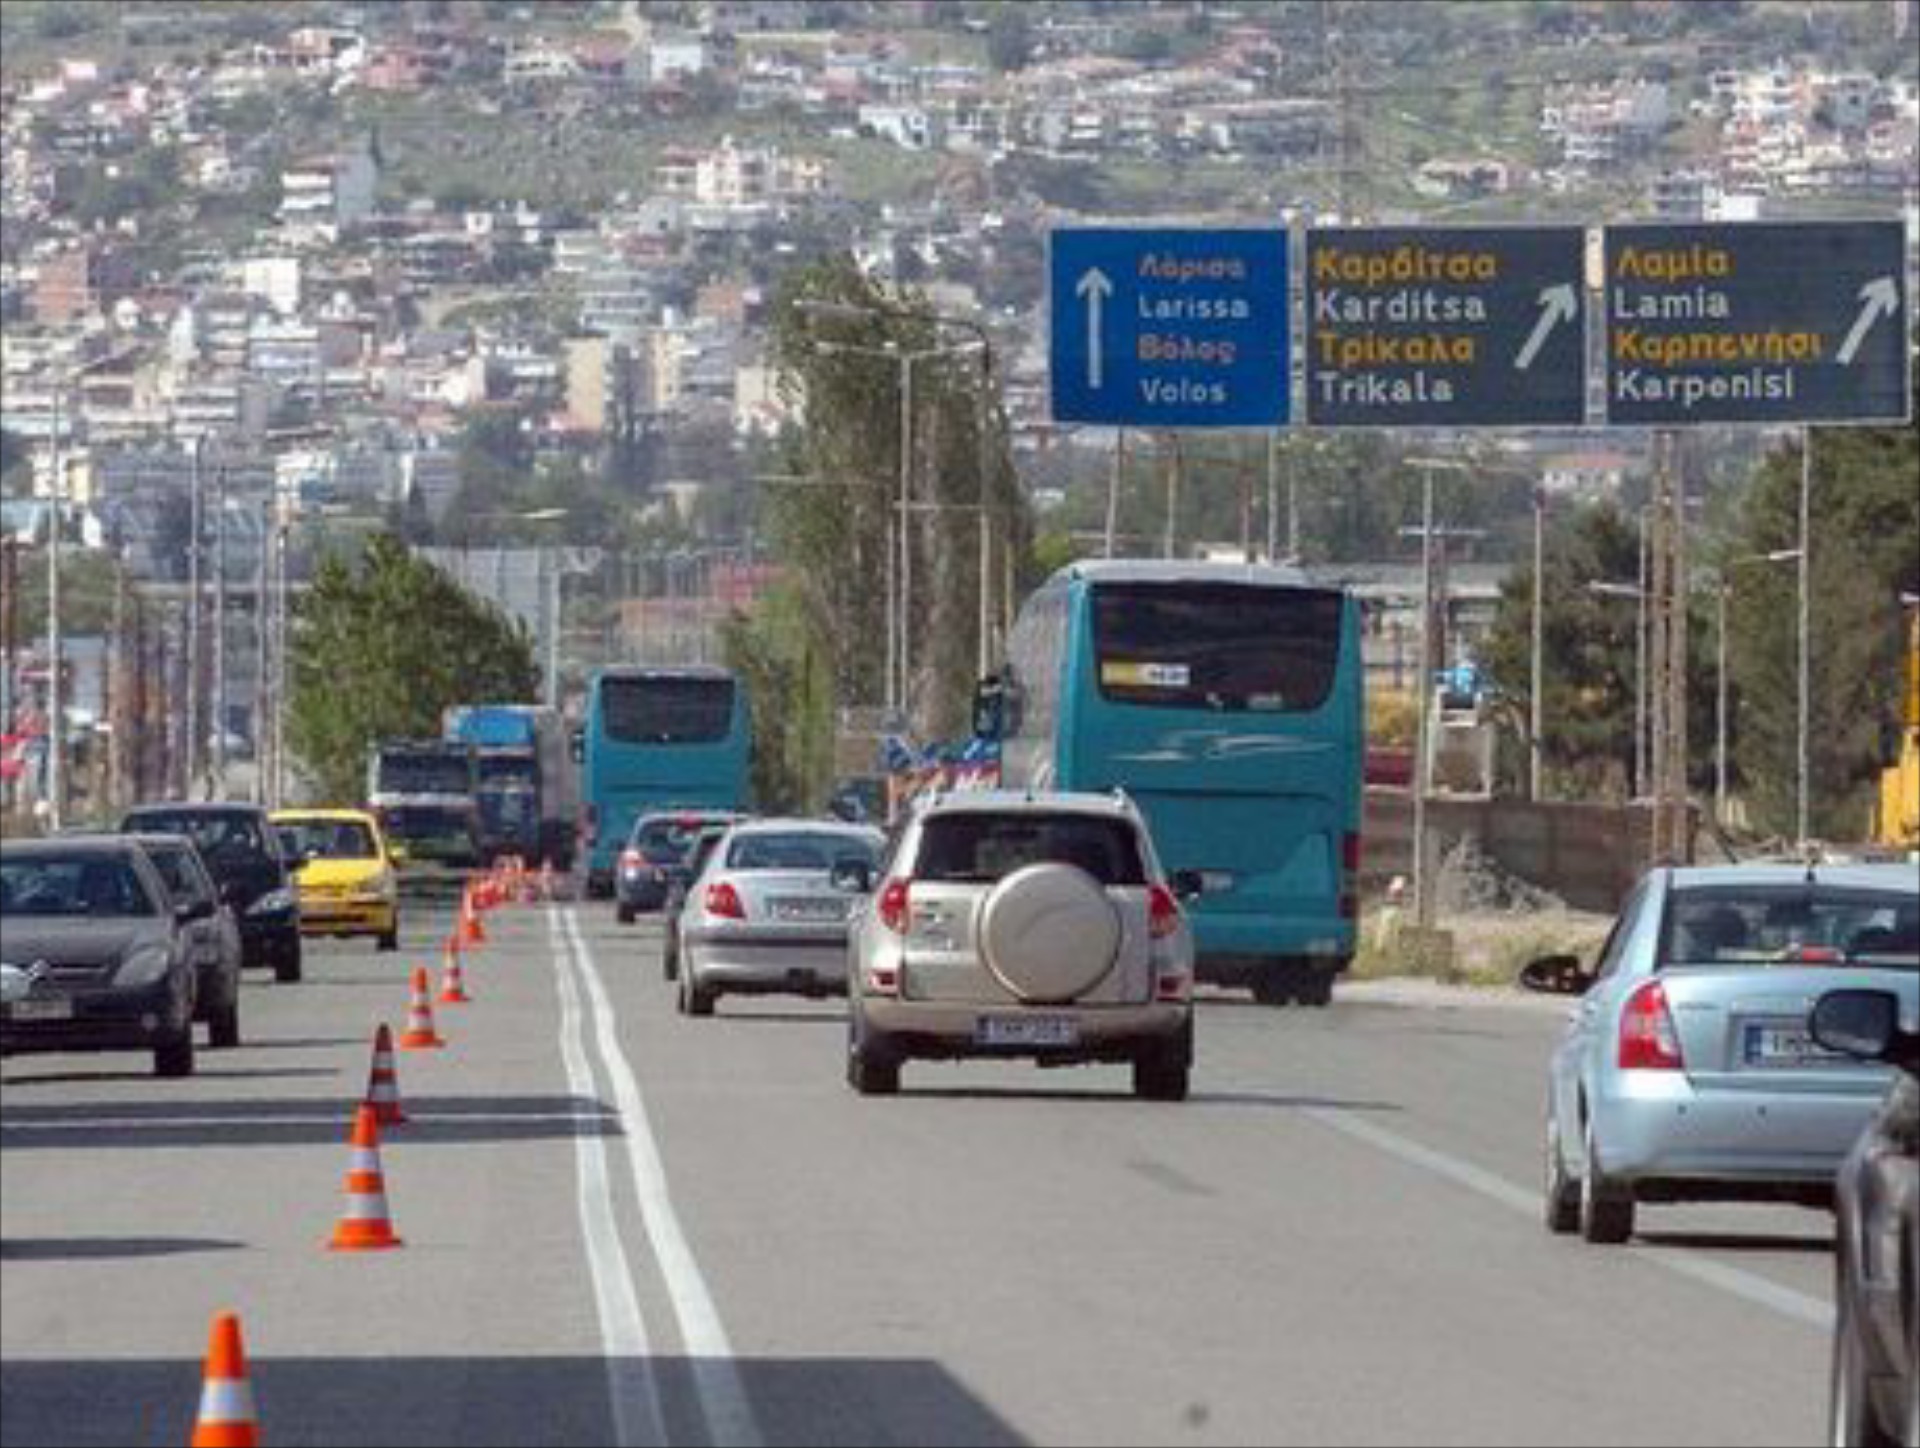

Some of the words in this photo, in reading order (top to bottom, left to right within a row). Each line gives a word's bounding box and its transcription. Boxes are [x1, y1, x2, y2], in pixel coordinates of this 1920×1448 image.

[1315, 247, 1497, 285] Καρδίτσα
[1616, 246, 1731, 281] Λαμία
[1138, 295, 1249, 318] Larissa
[1315, 289, 1486, 321] Karditsa
[1614, 286, 1729, 318] Lamia
[1139, 378, 1227, 402] Volos
[1316, 371, 1453, 402] Trikala
[1615, 368, 1793, 406] Karpenisi
